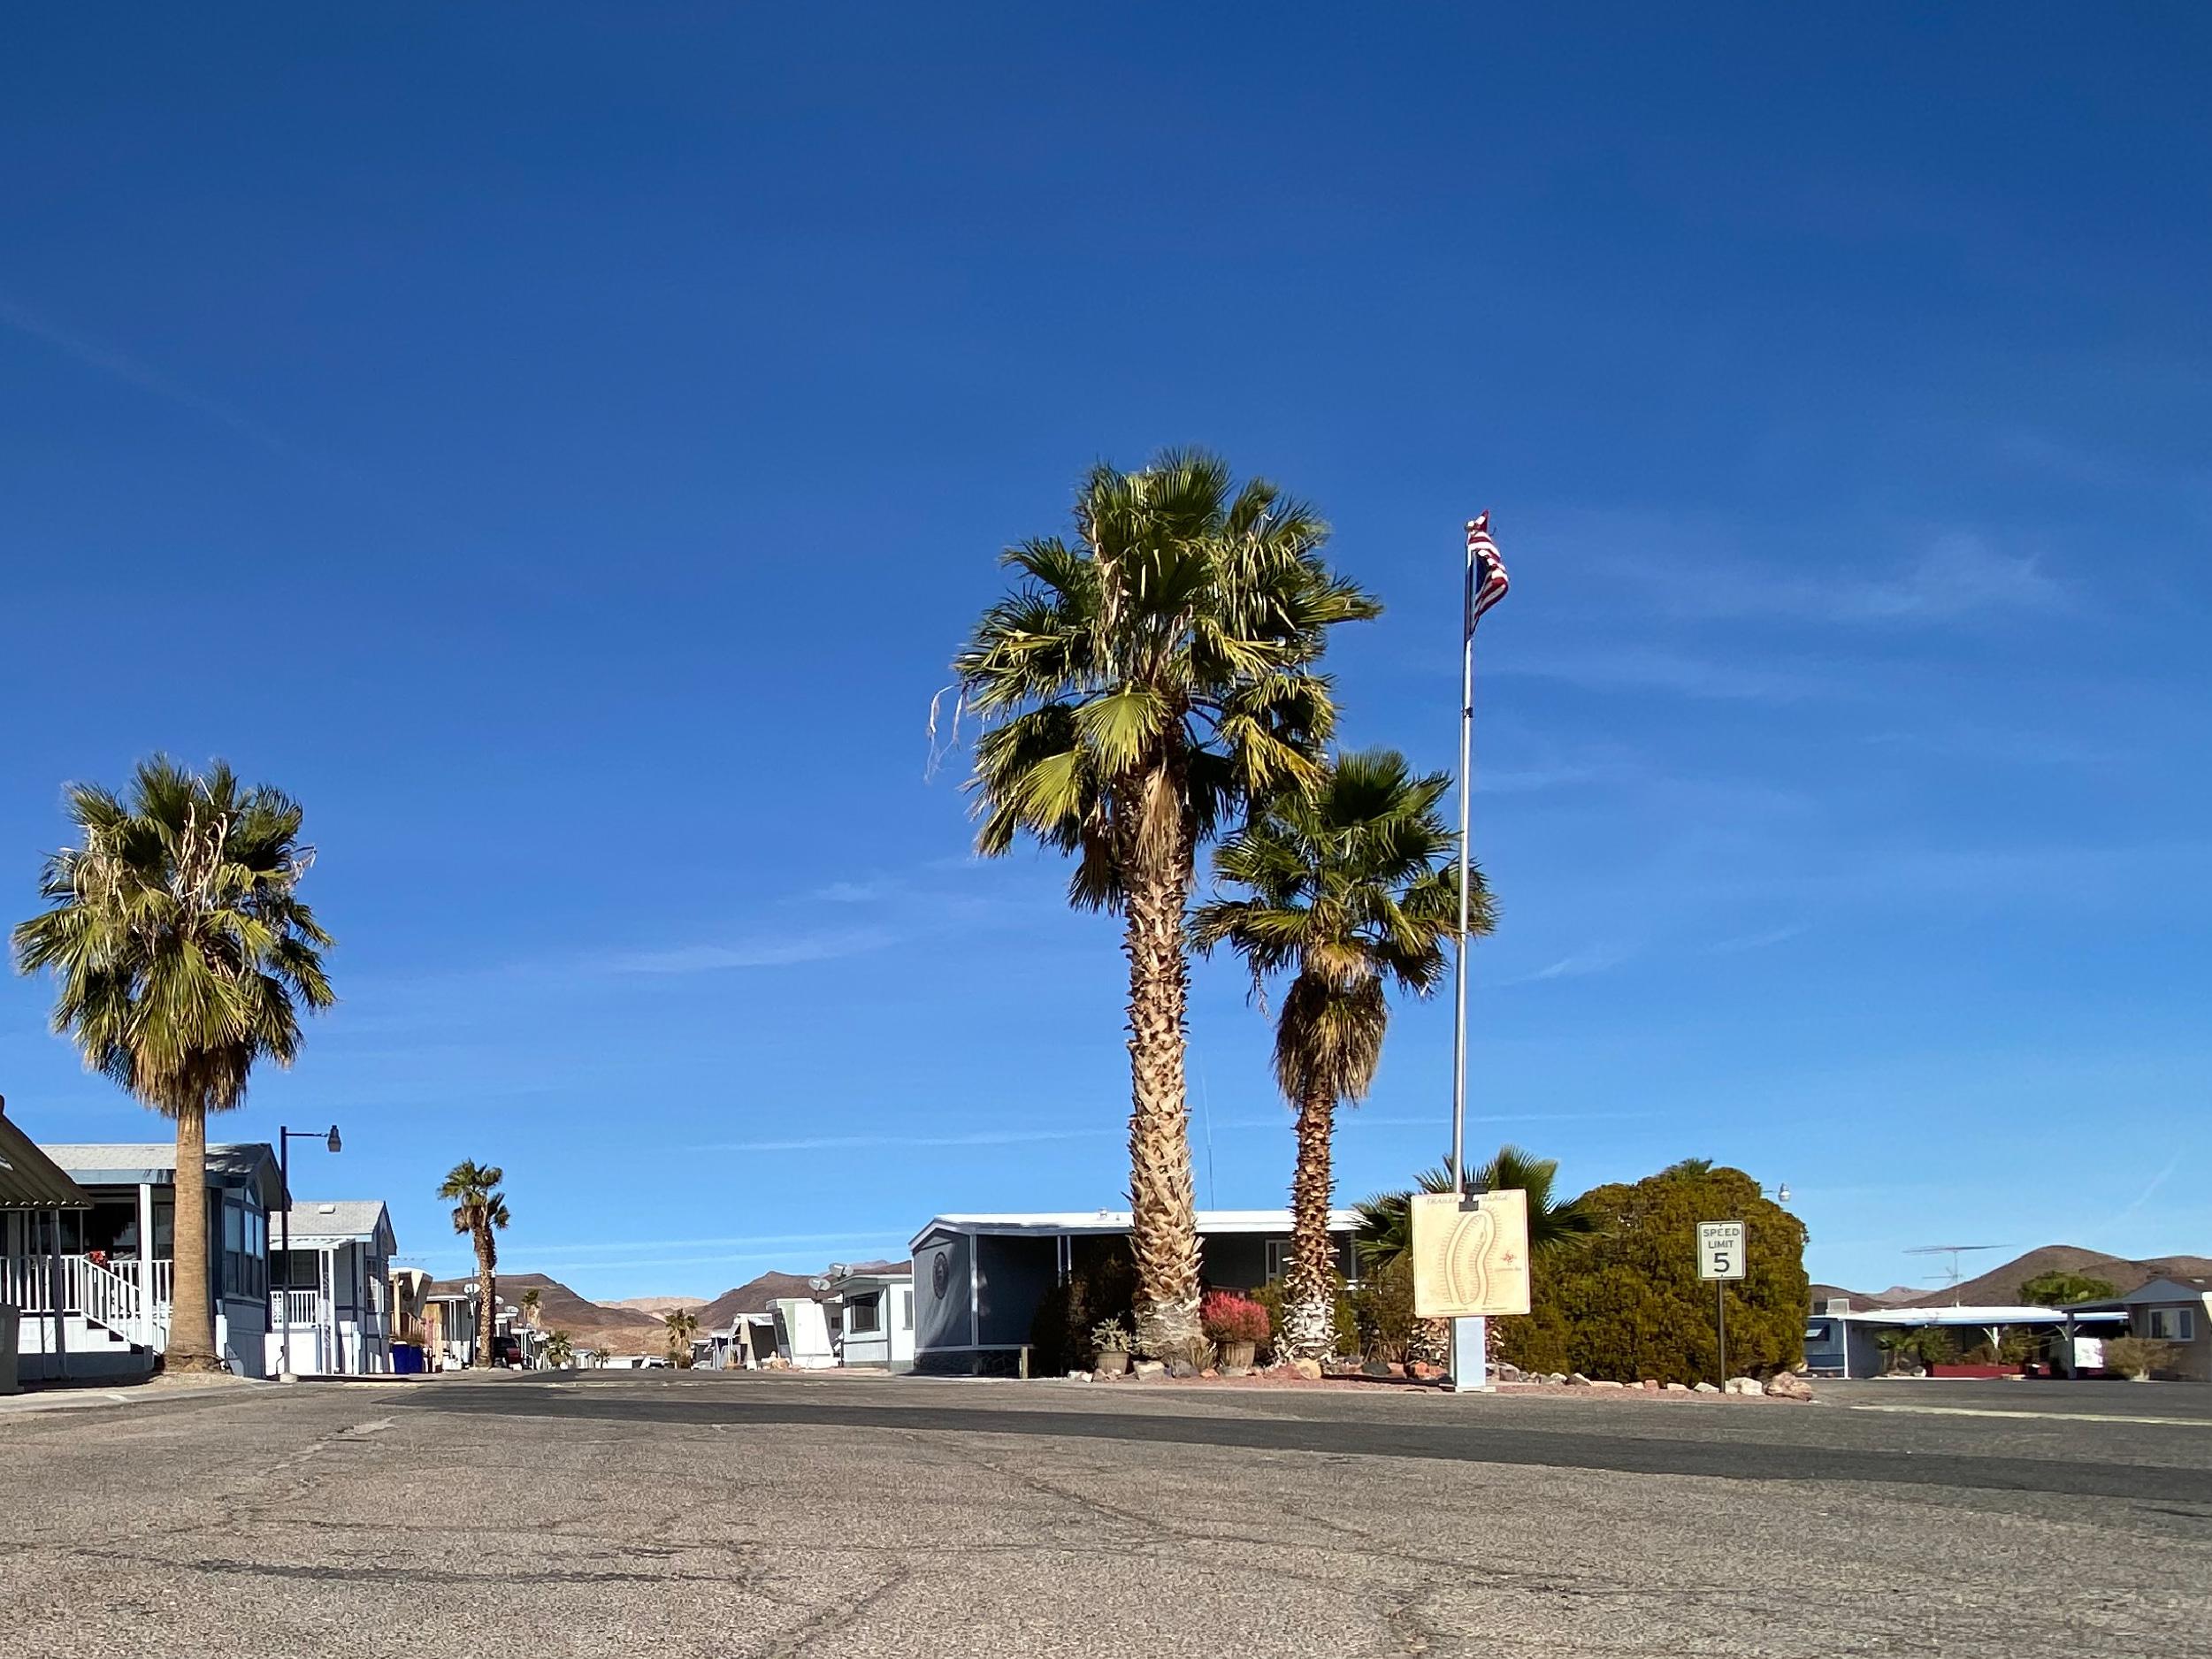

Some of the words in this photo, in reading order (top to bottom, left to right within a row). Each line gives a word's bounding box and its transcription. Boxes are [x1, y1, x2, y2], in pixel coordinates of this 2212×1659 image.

[1703, 1227, 1740, 1237] SPEED
[1708, 1240, 1734, 1249] LIMIT
[1714, 1252, 1729, 1273] 5
